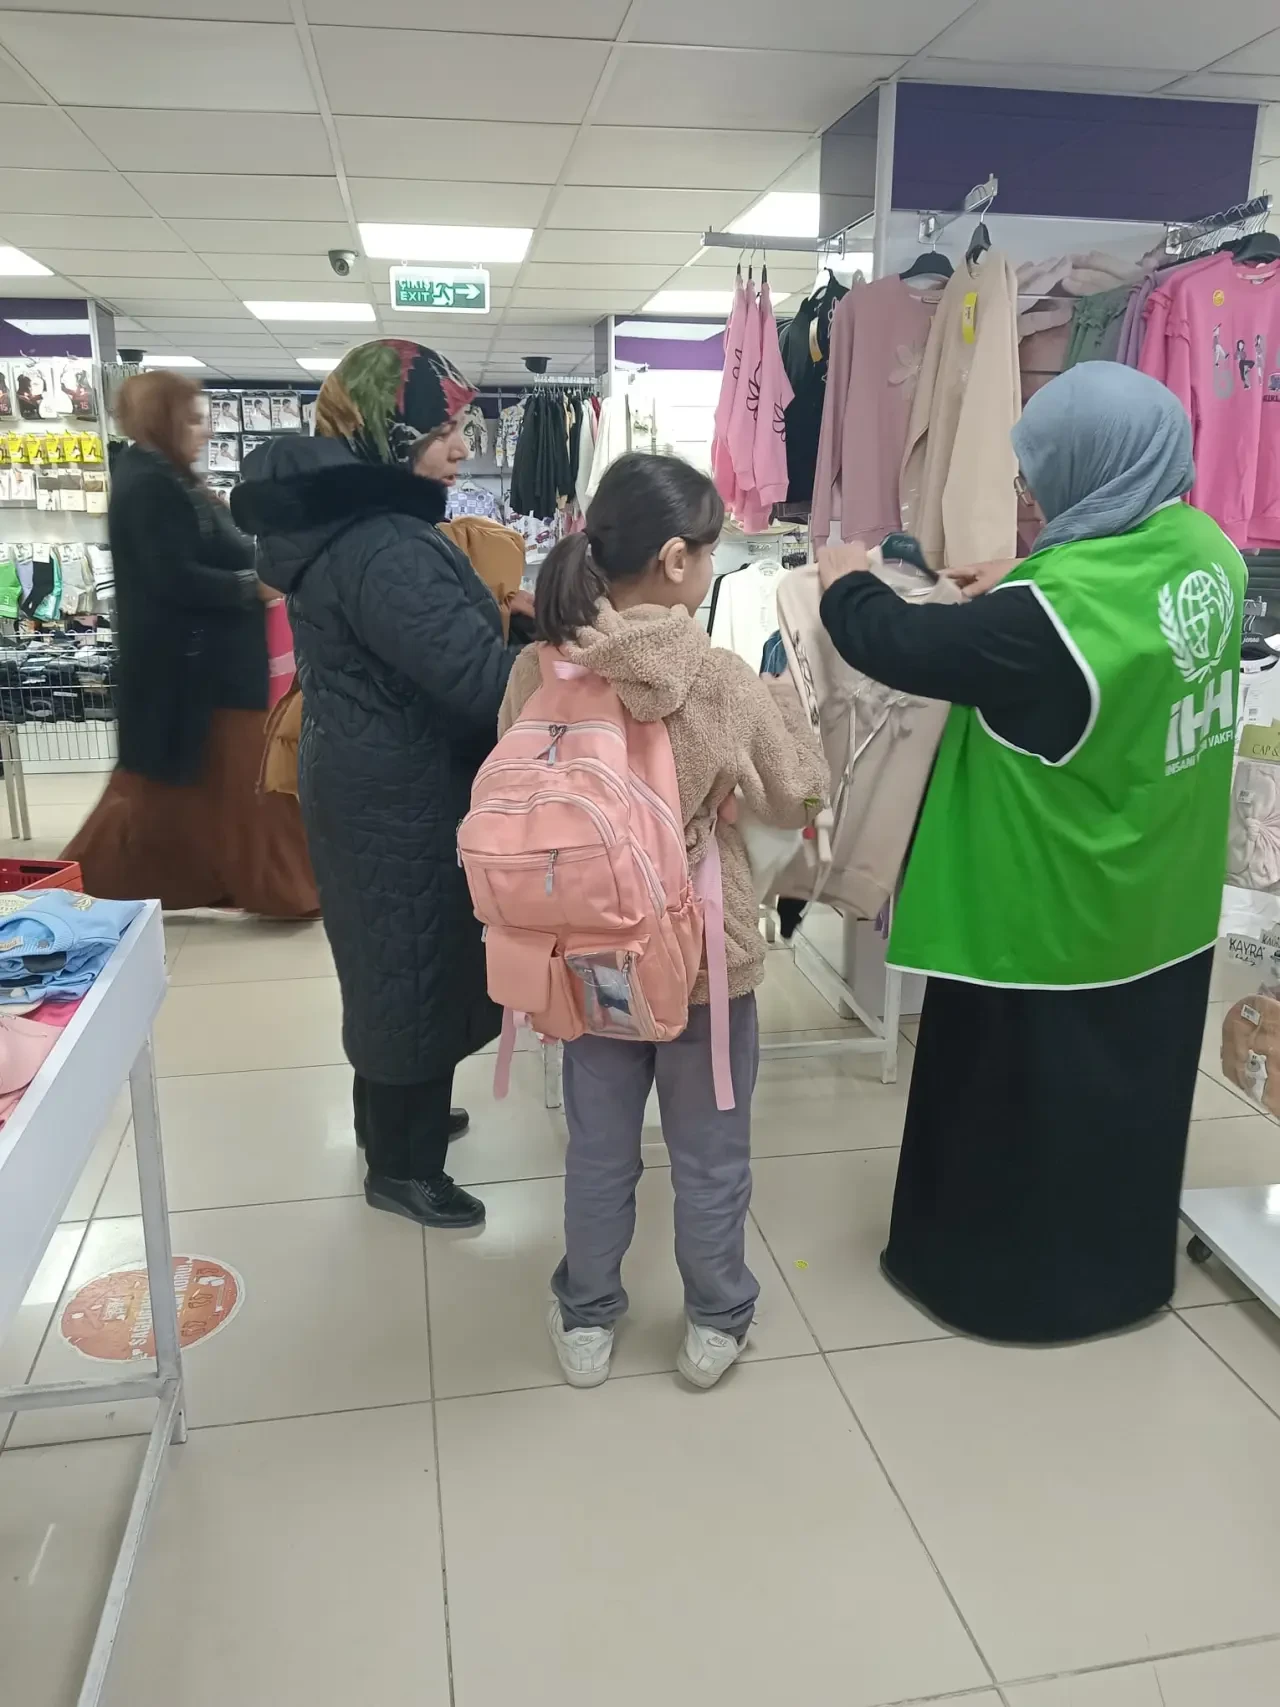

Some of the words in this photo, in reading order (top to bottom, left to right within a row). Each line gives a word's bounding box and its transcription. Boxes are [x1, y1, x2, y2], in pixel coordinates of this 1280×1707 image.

[400, 291, 430, 302] EXIT
[80, 401, 89, 409] 15
[1252, 743, 1271, 756] CAP
[1229, 937, 1263, 960] KAYRA
